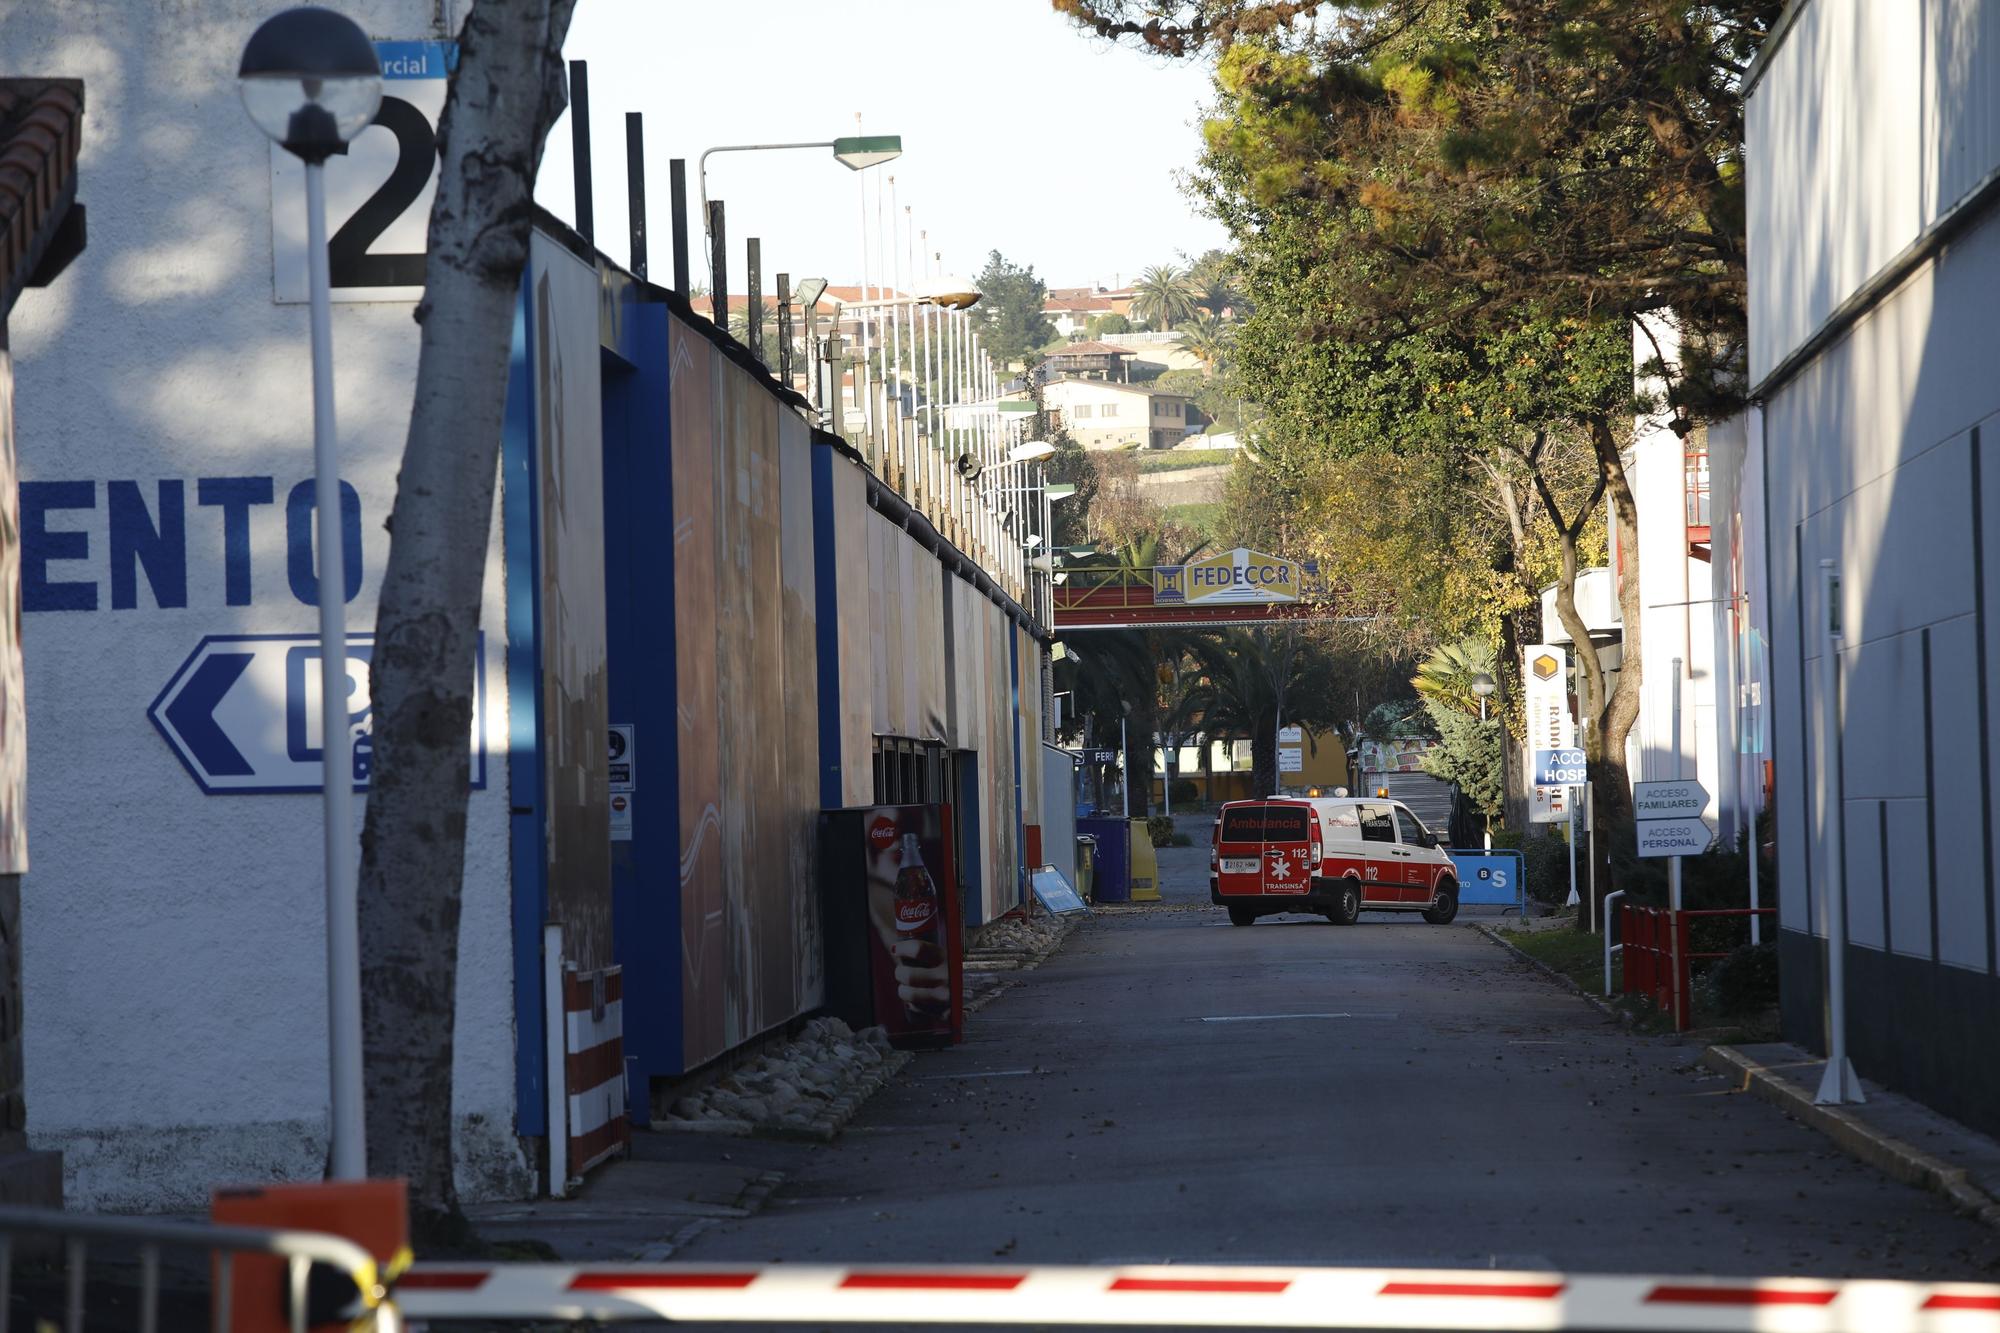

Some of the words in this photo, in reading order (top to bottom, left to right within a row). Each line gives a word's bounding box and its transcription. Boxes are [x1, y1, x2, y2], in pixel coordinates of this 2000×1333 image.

[383, 55, 428, 75] rcial
[328, 95, 438, 288] 2
[20, 475, 364, 613] ENTO
[1193, 565, 1290, 586] FEDECOR
[1550, 752, 1587, 765] ACCE
[1544, 769, 1587, 782] HOSP
[1646, 788, 1689, 799] ACCESO
[1638, 800, 1699, 810] FAMILIARES
[1229, 817, 1301, 830] Ambulancia
[1648, 827, 1692, 837] ACCESO
[1642, 838, 1699, 849] PERSONAL
[1291, 848, 1308, 859] 112
[1365, 866, 1378, 881] 112
